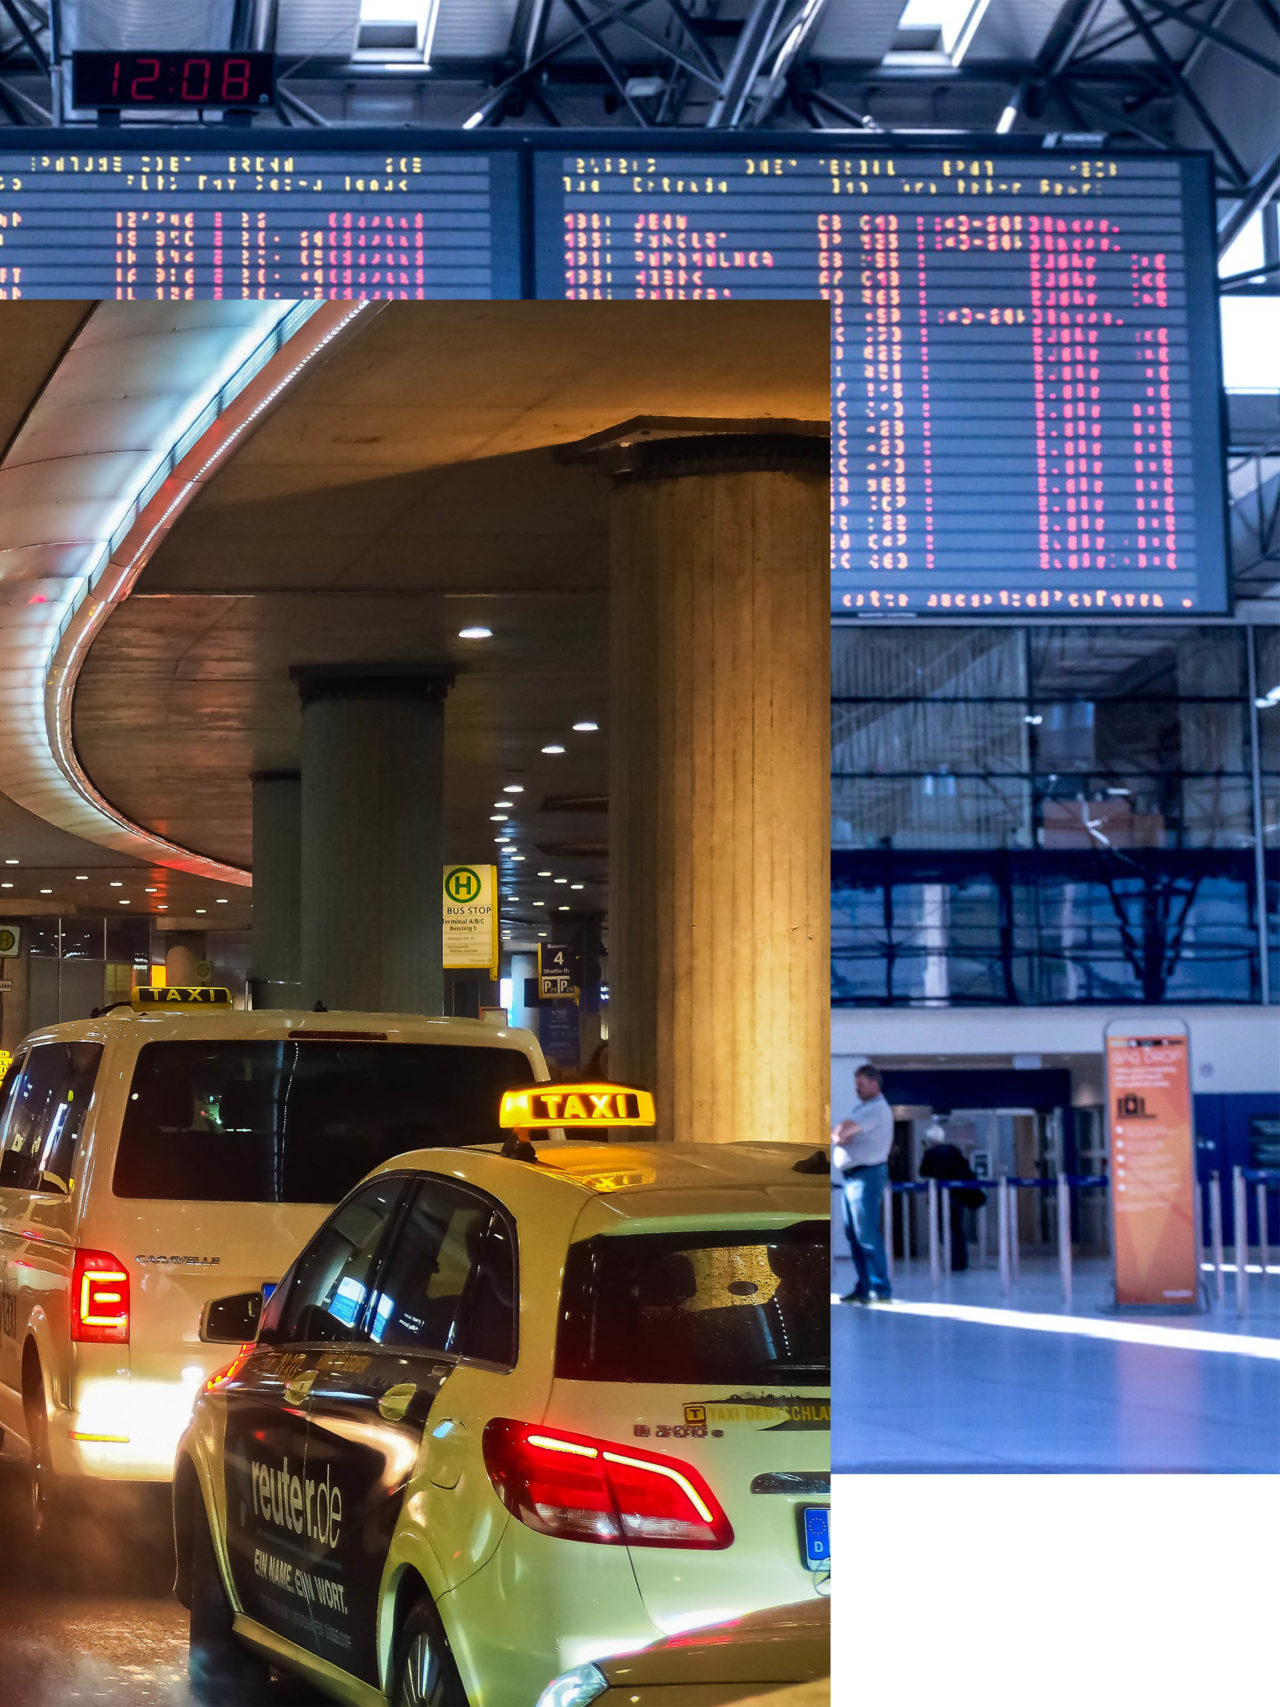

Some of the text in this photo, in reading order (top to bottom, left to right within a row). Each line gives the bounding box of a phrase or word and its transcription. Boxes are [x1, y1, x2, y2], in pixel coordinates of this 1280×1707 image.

[112, 58, 251, 100] 12:08
[454, 875, 472, 896] H
[447, 906, 492, 915] BUS STOP
[553, 951, 564, 966] 4
[148, 988, 215, 1001] TAXI
[540, 1094, 627, 1119] TAXI
[134, 1254, 220, 1266] CARAVELLE
[710, 1407, 741, 1422] TAXI
[251, 1456, 342, 1549] reuter.de
[813, 1540, 825, 1553] D
[254, 1548, 348, 1615] EIN NAME. EIN WORT.
